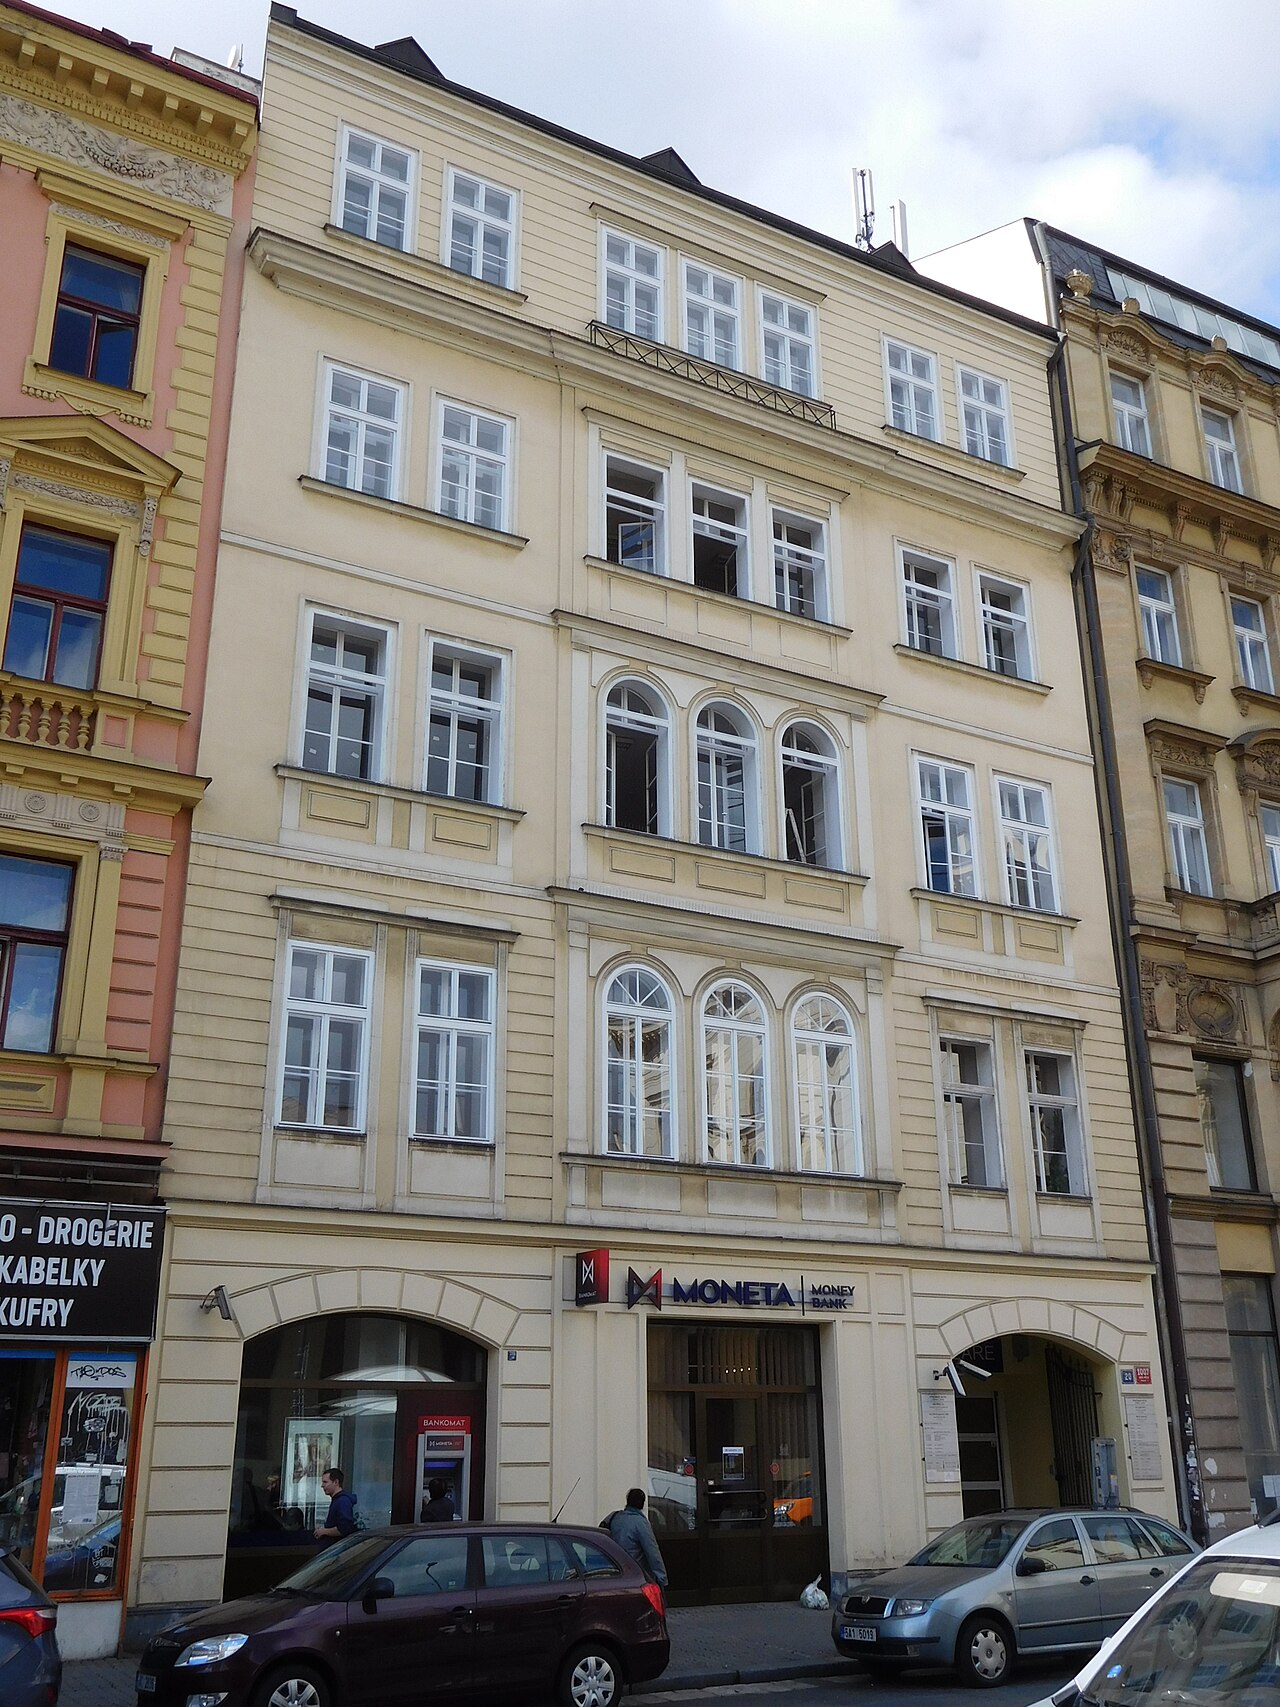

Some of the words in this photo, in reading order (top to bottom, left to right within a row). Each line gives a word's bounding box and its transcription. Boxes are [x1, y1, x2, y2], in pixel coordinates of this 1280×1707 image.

[37, 1216, 154, 1249] DROGERIE
[0, 1255, 106, 1287] KABELKY
[673, 1277, 796, 1307] MONETA
[811, 1283, 856, 1297] MONEY
[811, 1297, 848, 1310] BANK
